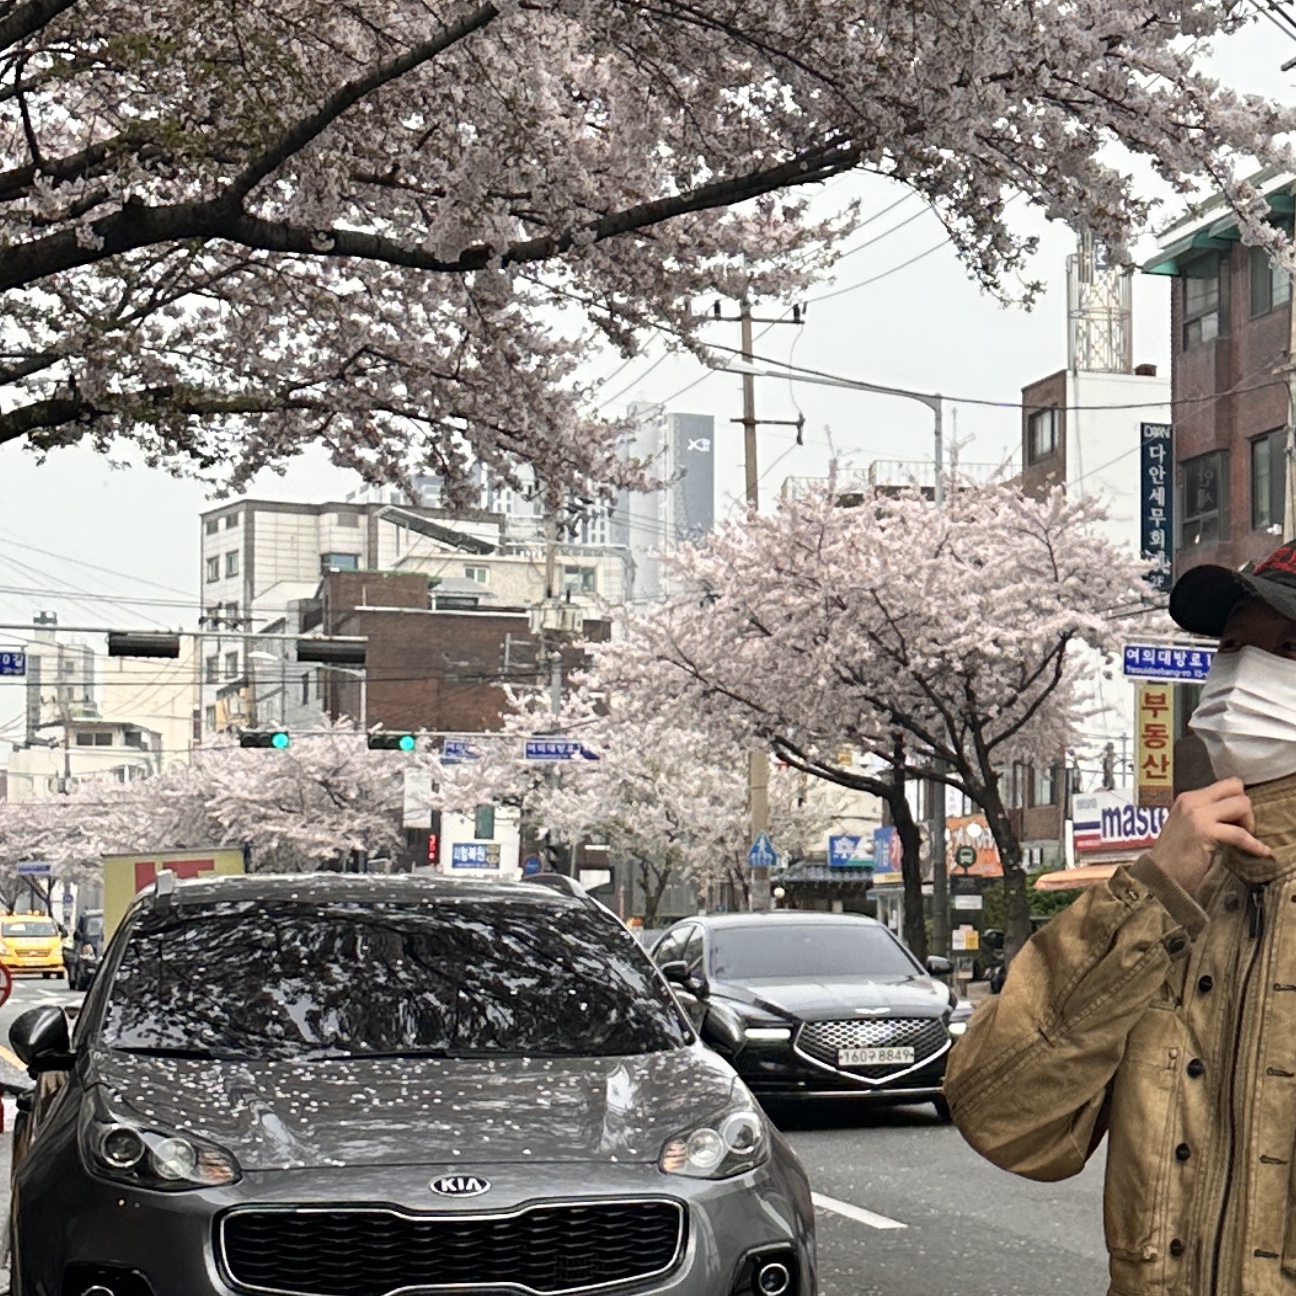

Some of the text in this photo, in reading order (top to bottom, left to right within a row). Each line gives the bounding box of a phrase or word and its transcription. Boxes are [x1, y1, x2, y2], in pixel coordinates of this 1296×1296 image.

[0, 653, 24, 667] 0길
[1126, 648, 1212, 668] 여의대방로1
[1140, 692, 1171, 779] 부동산
[1101, 803, 1170, 839] maste
[440, 1177, 482, 1192] KIA
